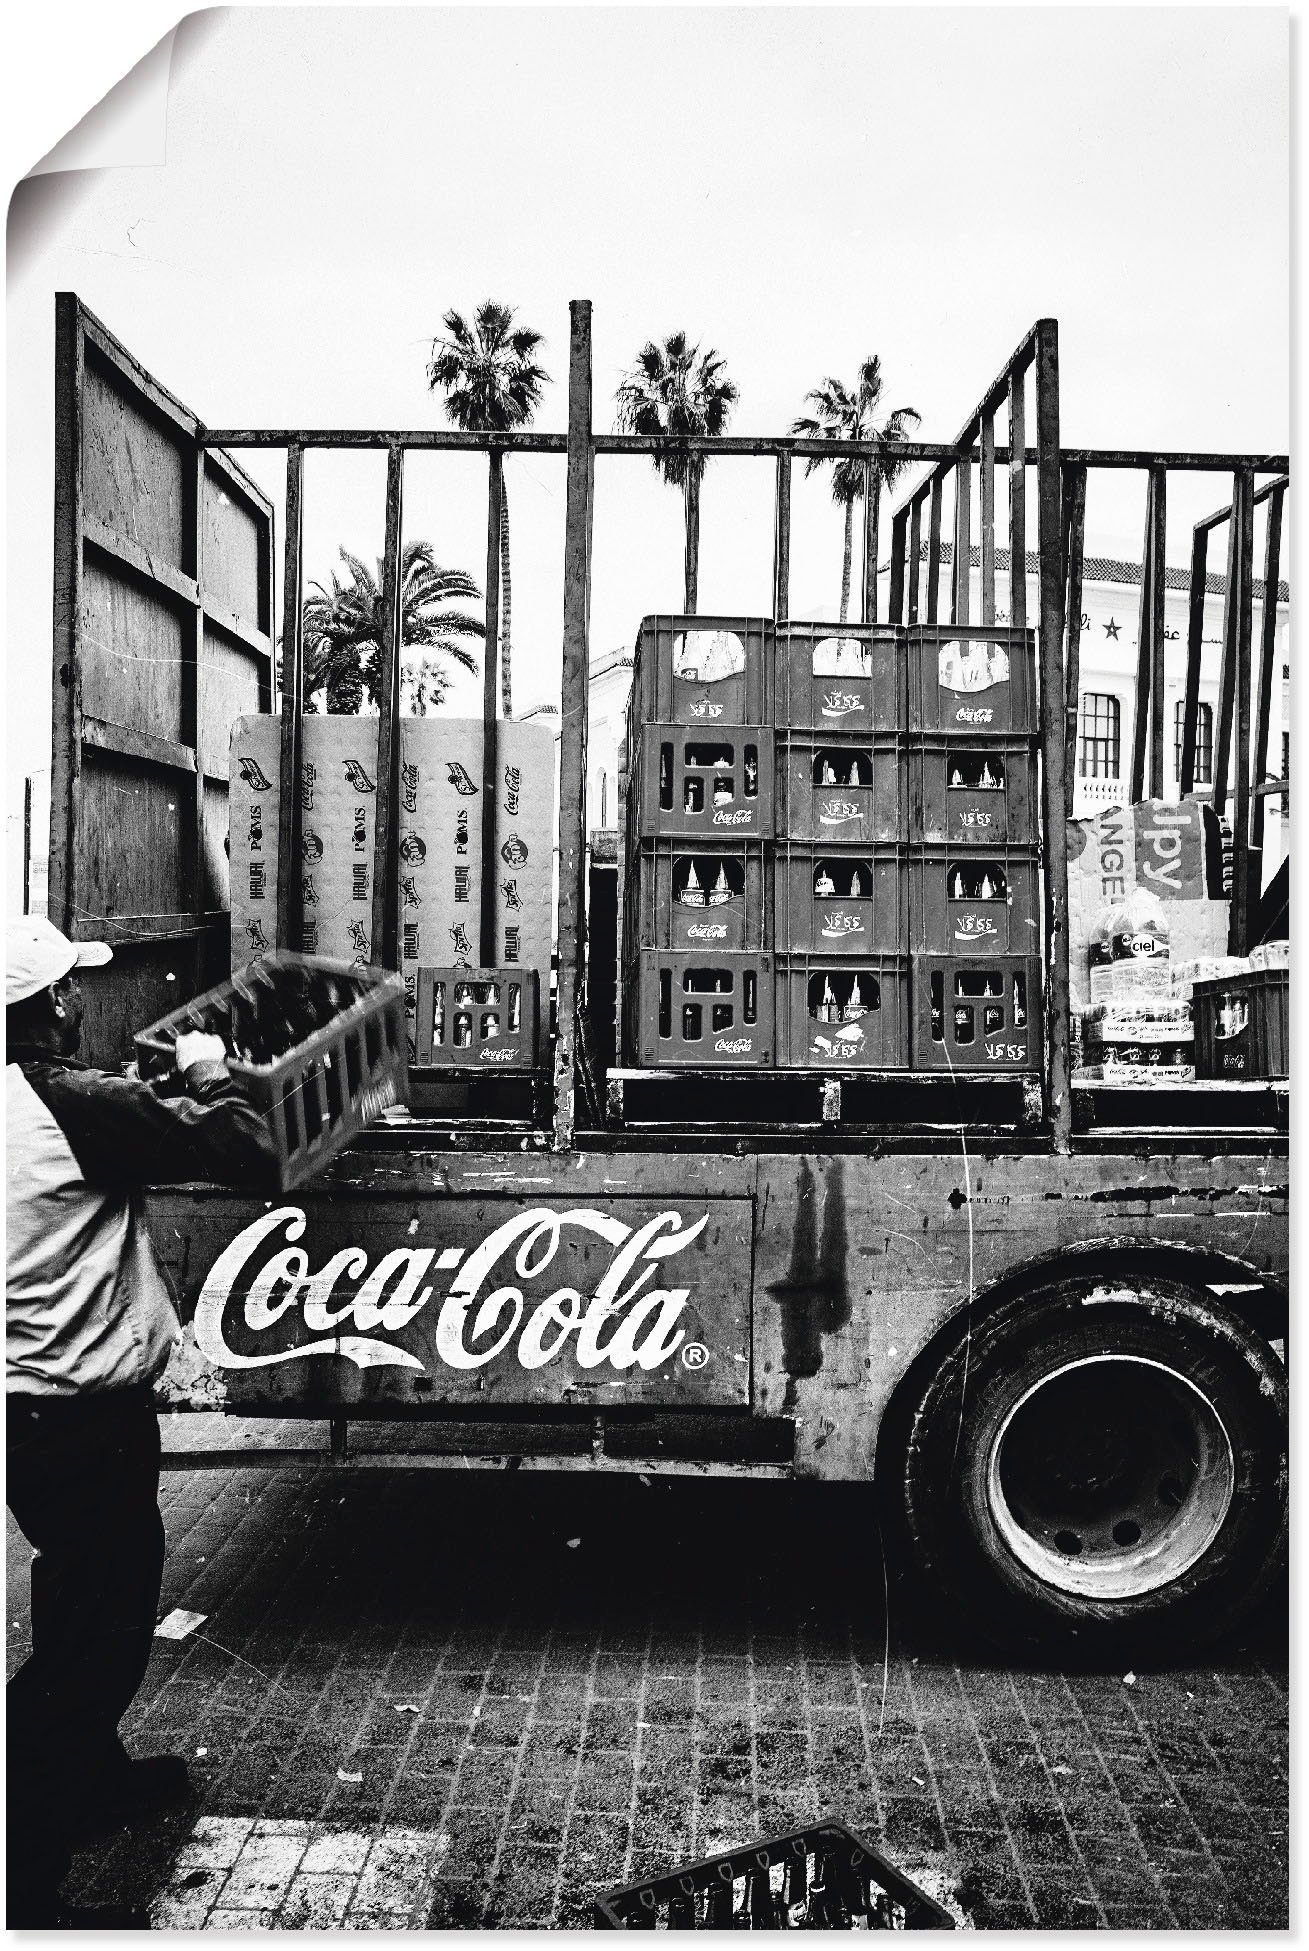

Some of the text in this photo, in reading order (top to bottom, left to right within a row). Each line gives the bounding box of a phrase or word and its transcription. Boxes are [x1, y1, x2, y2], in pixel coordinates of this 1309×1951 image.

[401, 763, 418, 813] Coca-Cola
[503, 764, 520, 816] Coca-Cola
[249, 805, 263, 852] POMS
[352, 807, 366, 853] POMS
[454, 809, 469, 855] POMS
[713, 808, 753, 826] Coca-Cola
[507, 833, 528, 870] Fanta
[250, 861, 265, 900] HAWAI
[353, 863, 367, 901] HAWAI
[402, 877, 419, 907] Sprite
[454, 865, 470, 903] HAWAI
[505, 879, 521, 908] Sprite
[249, 920, 266, 950] Sprite
[352, 920, 368, 951] Sprite
[403, 922, 419, 960] HAWAI
[453, 924, 470, 953] Sprite
[504, 925, 519, 963] HAWAI
[1132, 939, 1155, 952] ciel
[714, 1038, 753, 1054] Coca-Cola
[194, 1206, 710, 1370] Coca-Cola
